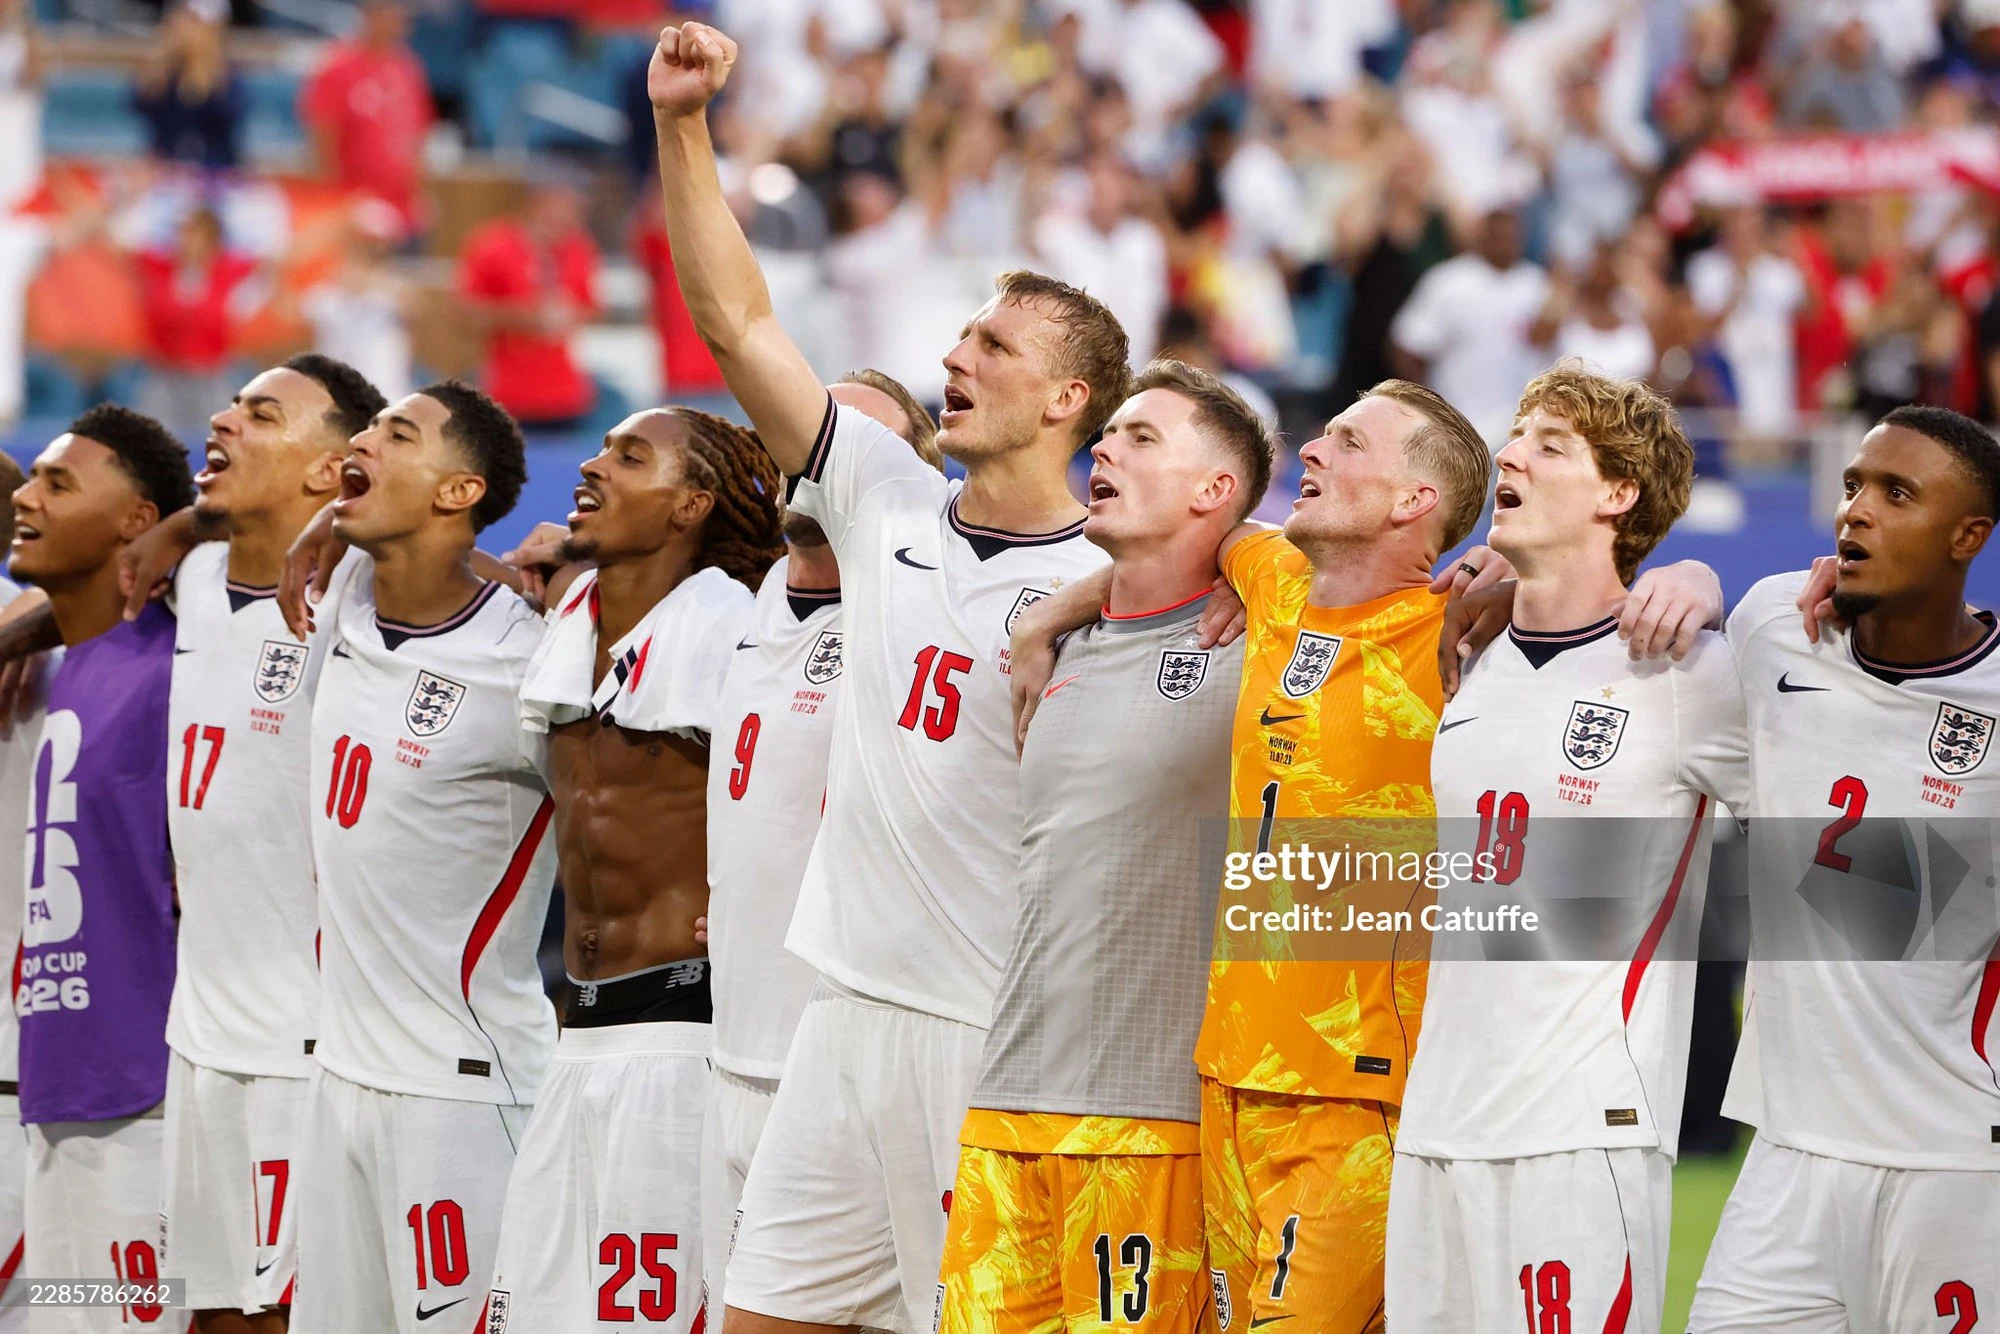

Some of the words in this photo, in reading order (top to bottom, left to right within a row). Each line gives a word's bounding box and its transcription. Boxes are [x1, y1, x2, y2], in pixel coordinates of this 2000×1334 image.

[793, 690, 827, 702] NORWAY
[898, 645, 974, 742] 15
[180, 723, 225, 810] 17
[326, 735, 372, 829] 10
[728, 713, 761, 800] 9
[1269, 735, 1297, 753] NORWAY
[1558, 773, 1601, 792] NORWAY
[1922, 774, 1964, 796] NORWAY
[1472, 790, 1530, 886] 18
[1558, 788, 1592, 805] 11.07.26
[1814, 775, 1868, 873] 2
[44, 951, 88, 973] CUP
[252, 1159, 289, 1247] 7
[407, 1199, 469, 1290] 10
[111, 1239, 163, 1324] 19
[598, 1232, 678, 1322] 25
[1093, 1233, 1153, 1325] 13
[1269, 1215, 1300, 1299] 1
[1519, 1260, 1571, 1334] 18
